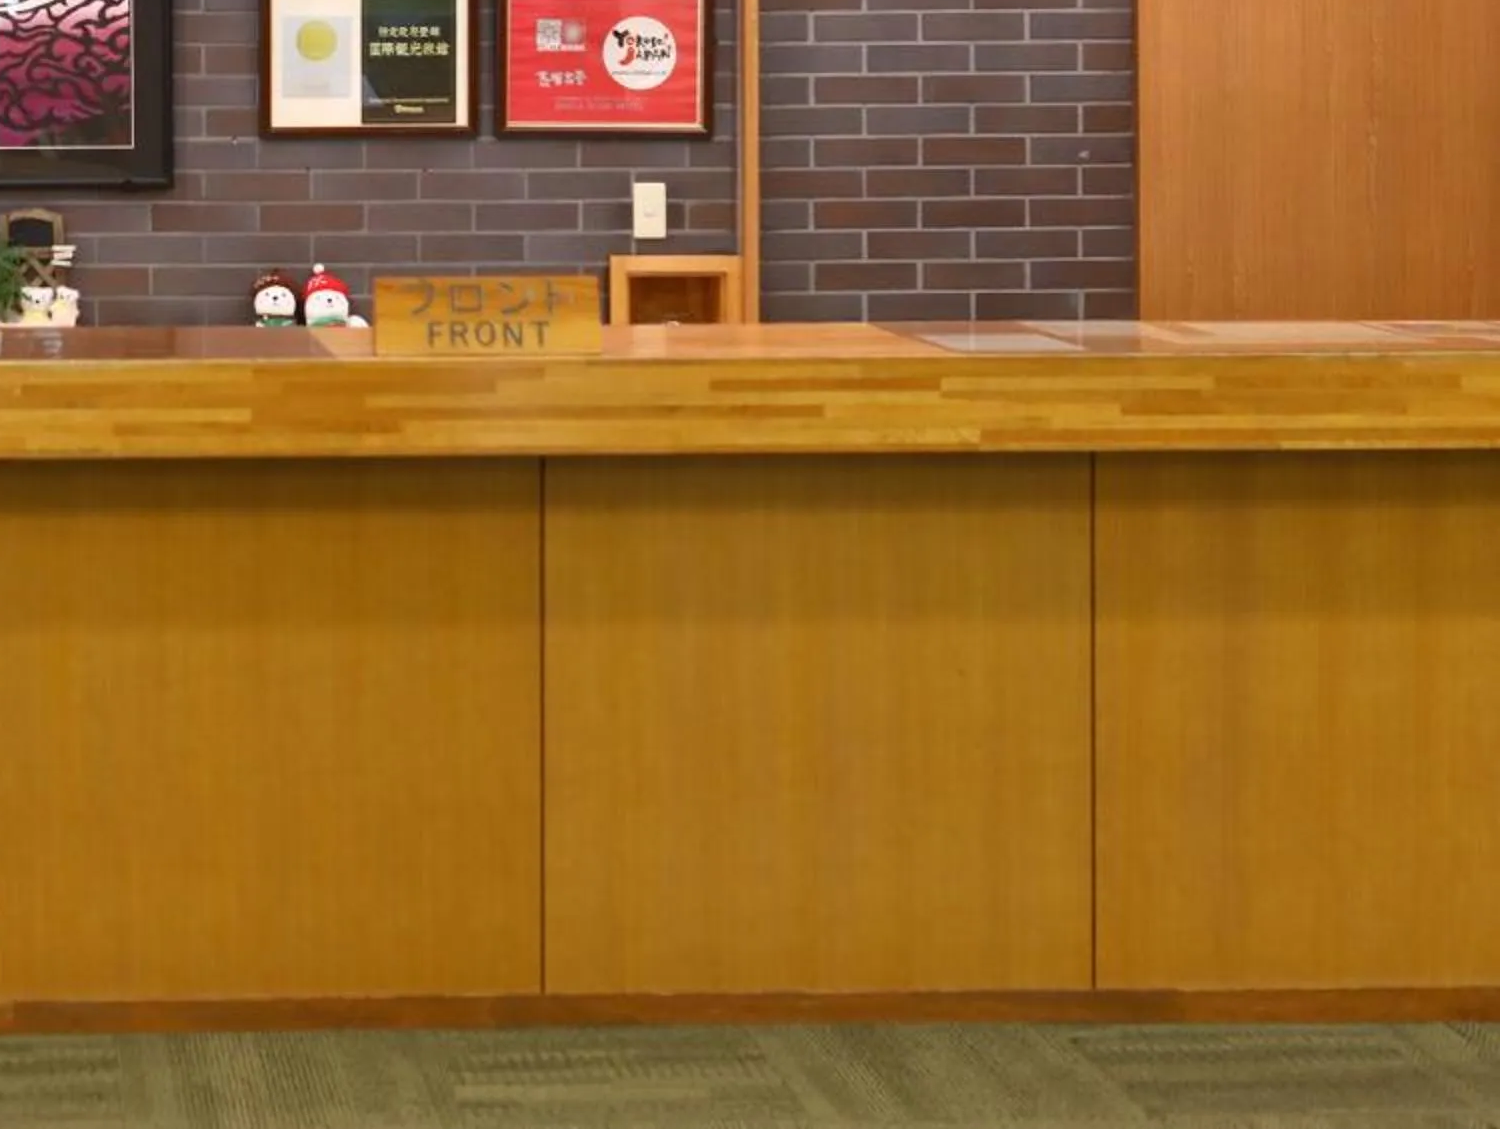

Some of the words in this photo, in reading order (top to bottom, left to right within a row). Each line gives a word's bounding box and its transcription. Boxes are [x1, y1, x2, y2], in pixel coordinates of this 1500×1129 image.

[405, 278, 577, 316] フロント
[426, 321, 551, 349] FRONT
